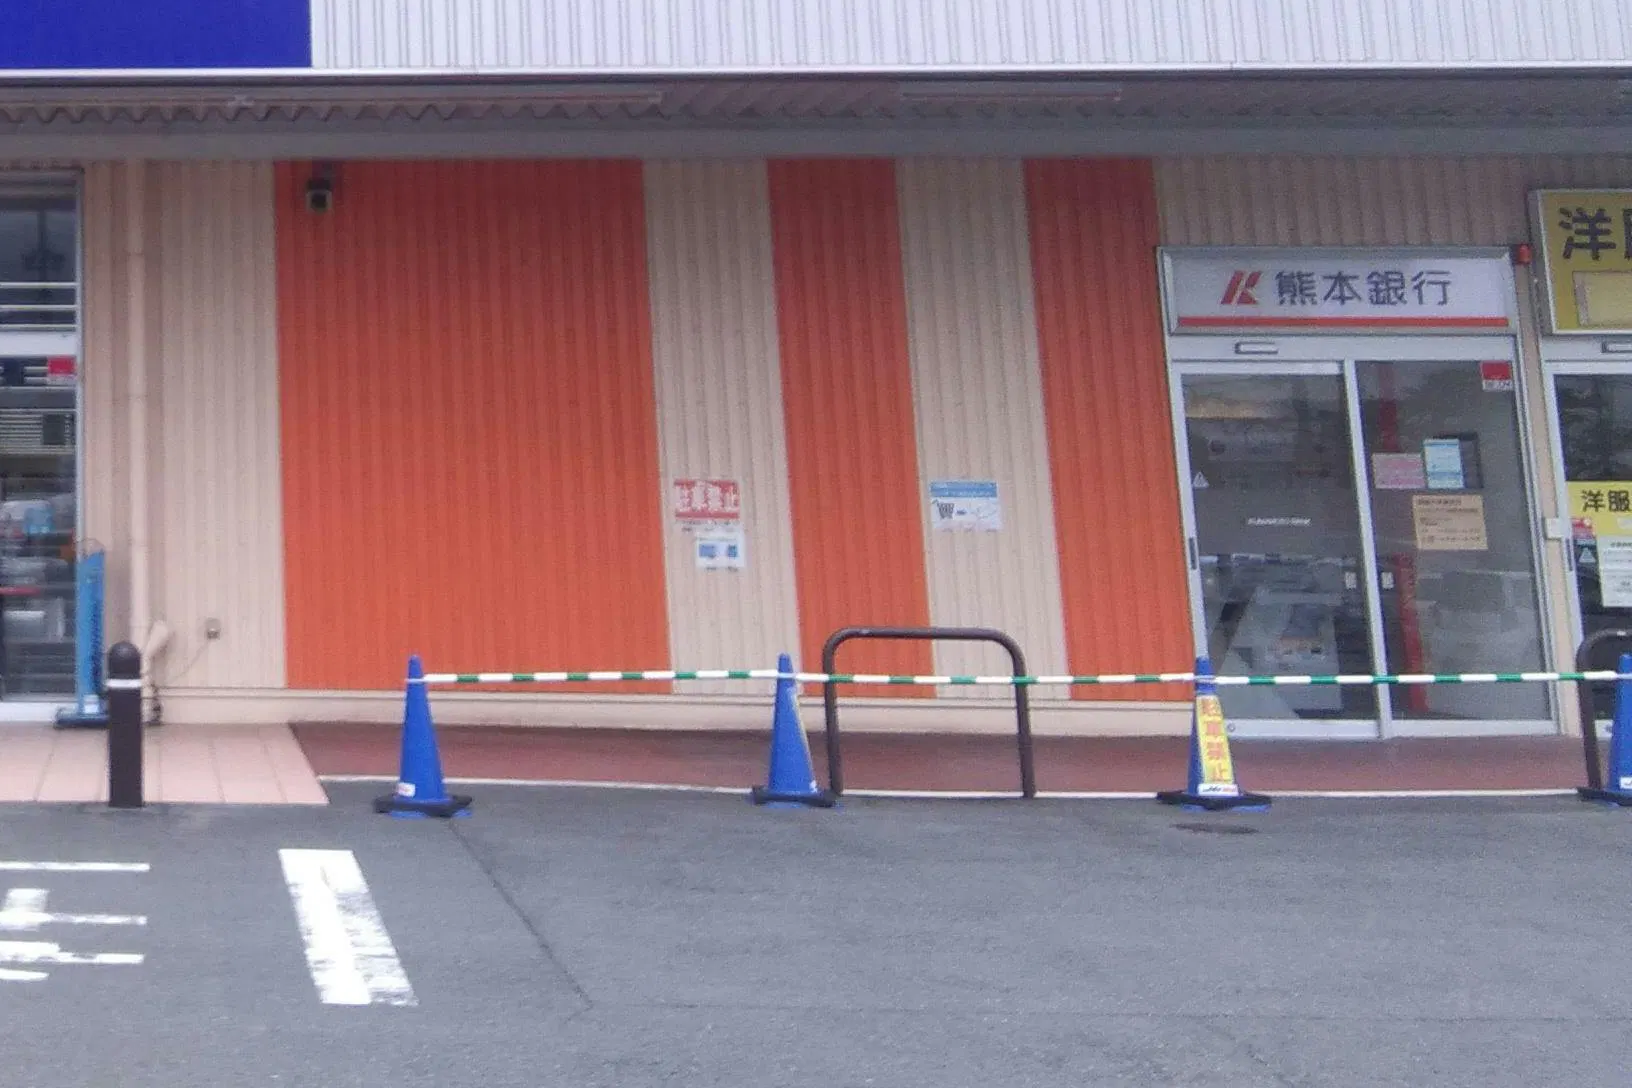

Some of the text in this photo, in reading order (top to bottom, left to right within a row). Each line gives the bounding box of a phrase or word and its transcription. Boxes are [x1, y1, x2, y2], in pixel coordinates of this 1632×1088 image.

[1558, 206, 1632, 261] 洋
[1275, 270, 1452, 307] 熊本銀行
